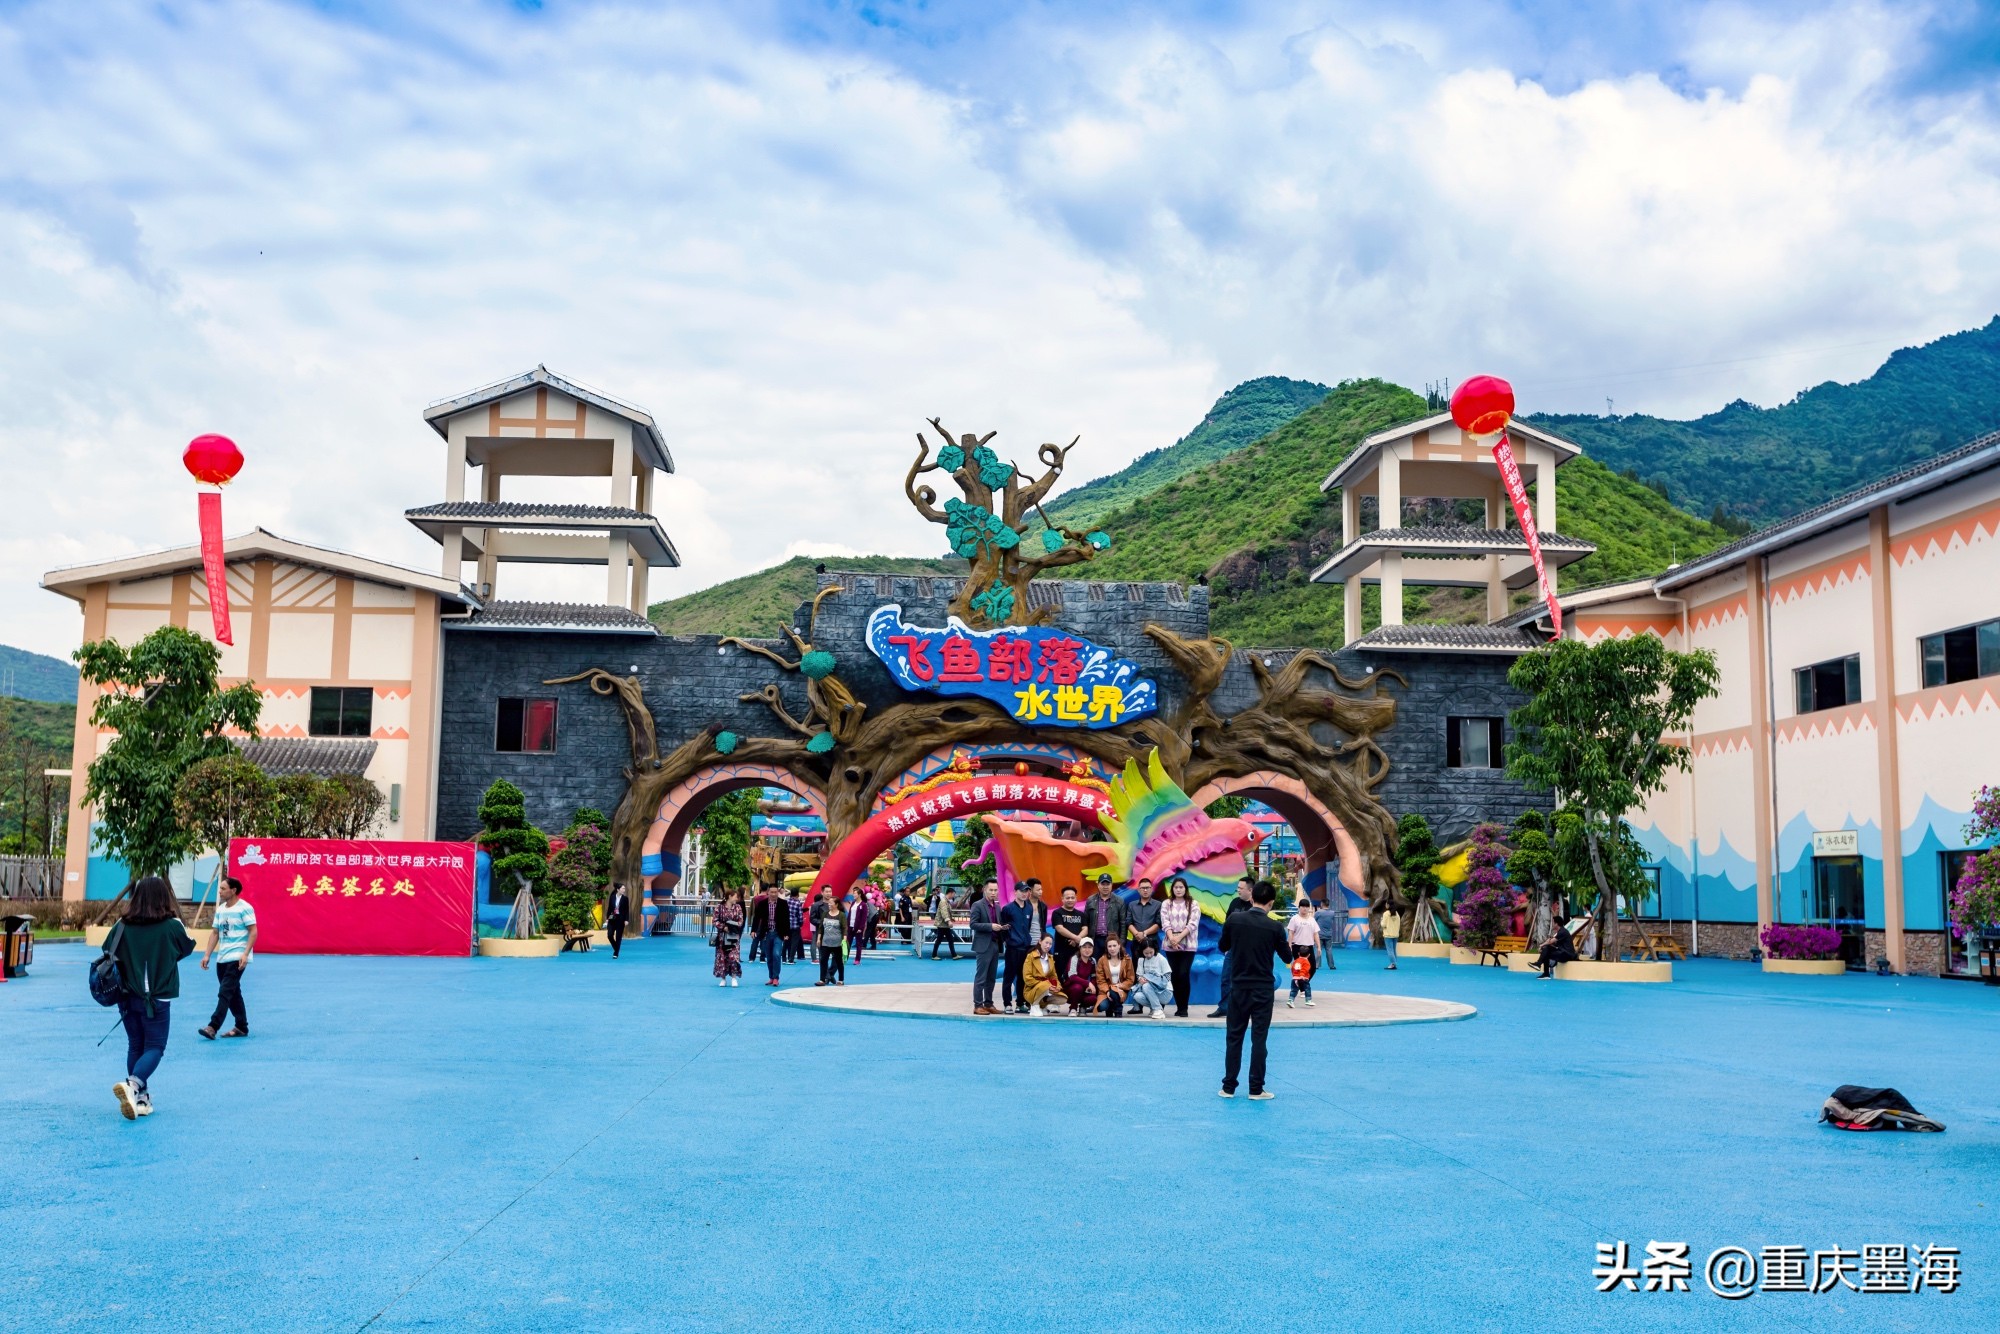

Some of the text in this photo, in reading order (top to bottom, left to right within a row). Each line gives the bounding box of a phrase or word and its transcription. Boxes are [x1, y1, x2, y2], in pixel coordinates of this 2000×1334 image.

[888, 635, 1084, 685] 飞鱼部落
[1014, 683, 1126, 723] 水世界
[887, 783, 1118, 833] 热烈祝贺飞鱼部落水世界盛大
[269, 852, 464, 869] 热烈祝贺飞鱼部落水世界盛大开园
[286, 874, 416, 897] 嘉宾签名处
